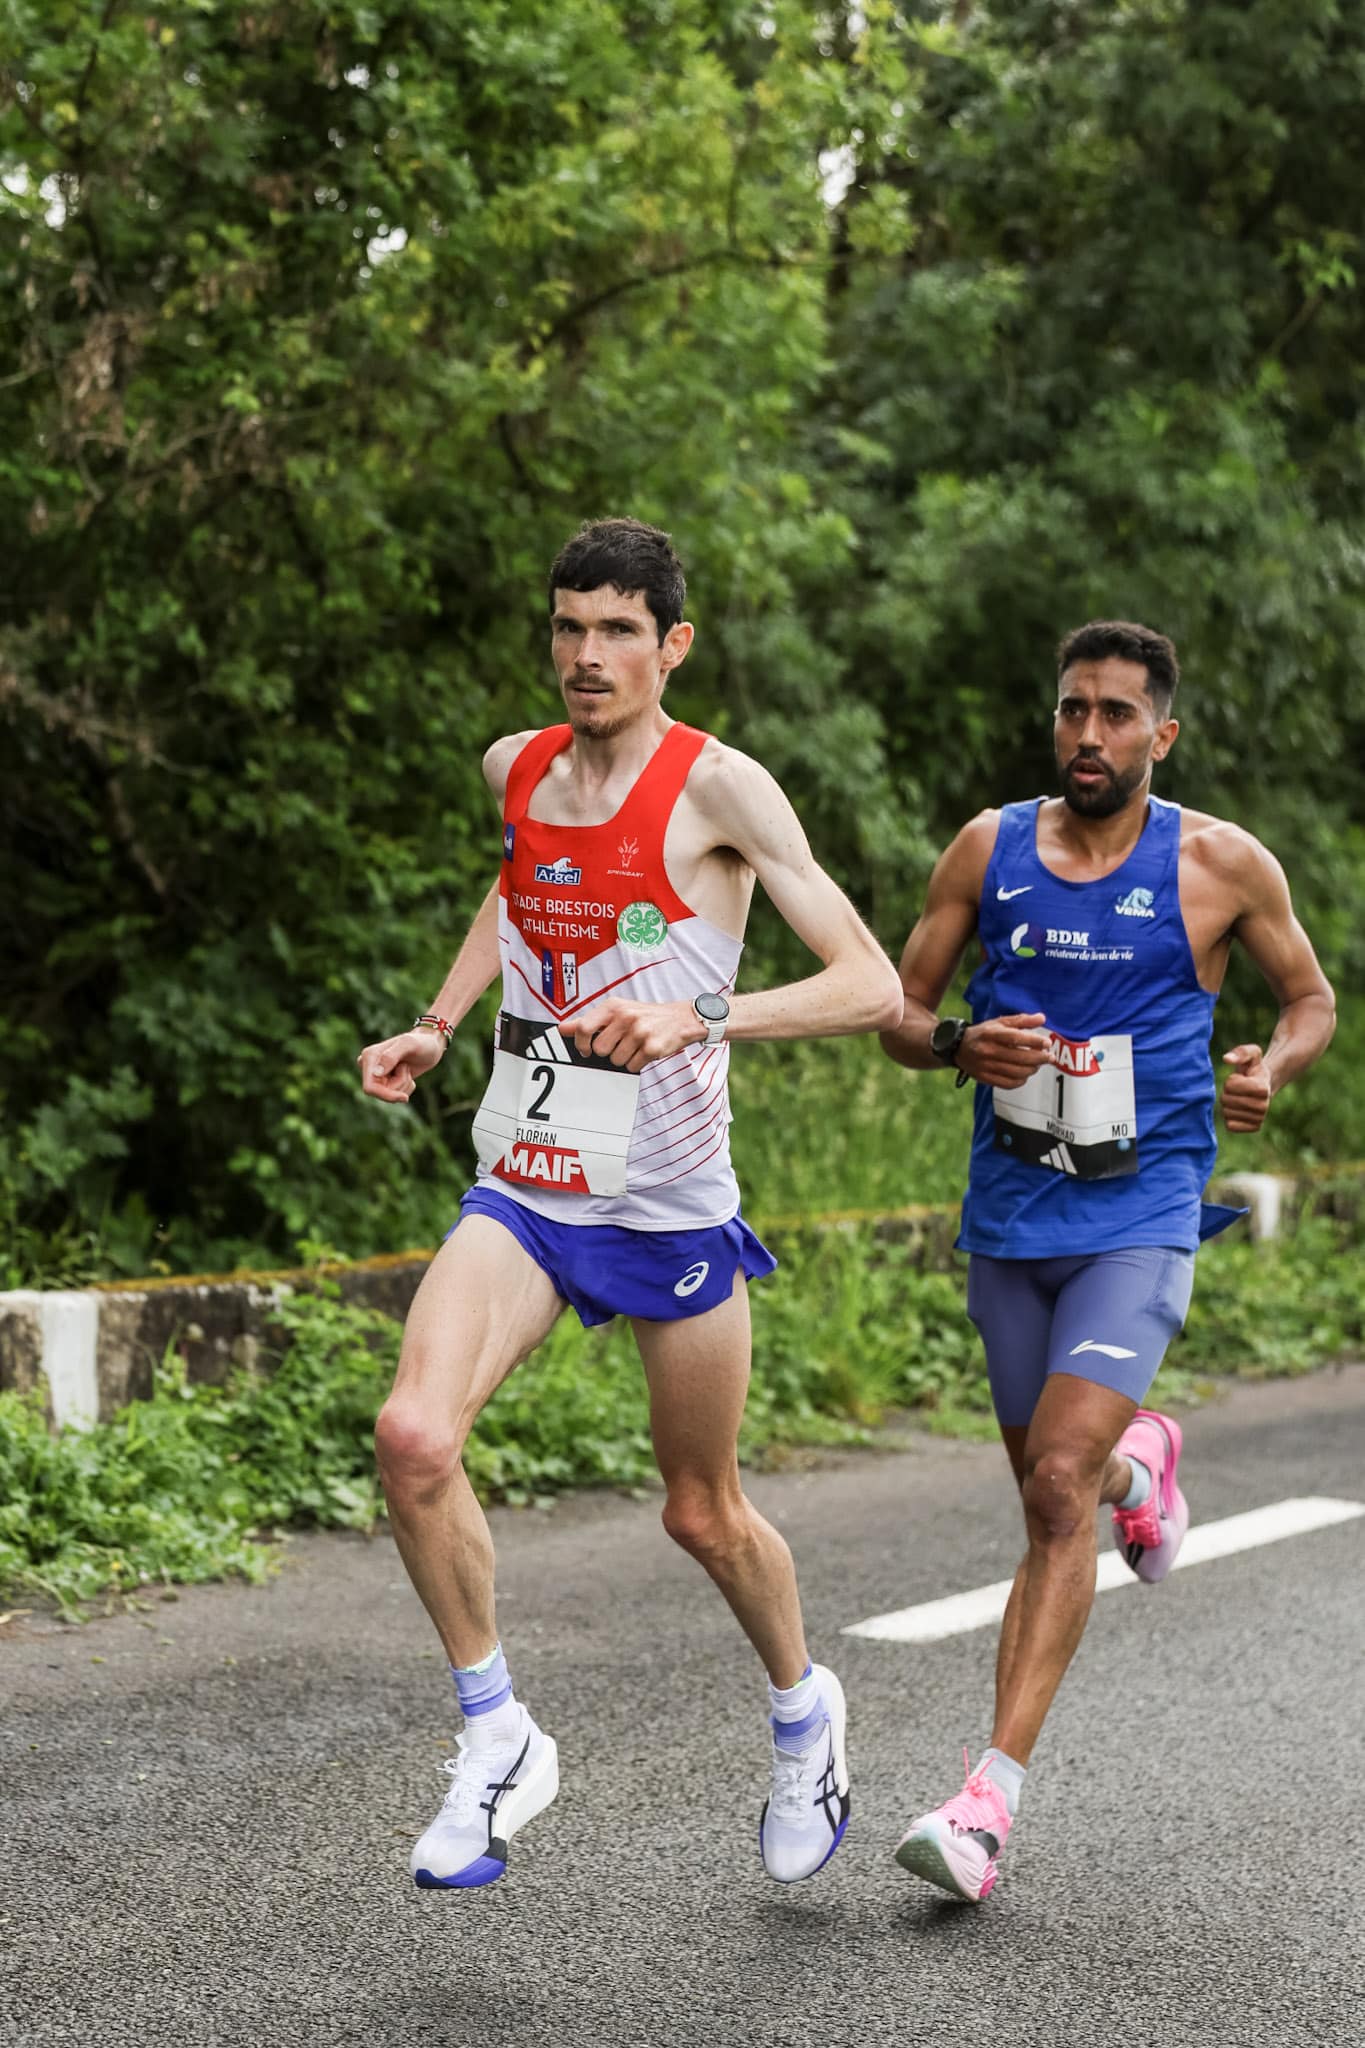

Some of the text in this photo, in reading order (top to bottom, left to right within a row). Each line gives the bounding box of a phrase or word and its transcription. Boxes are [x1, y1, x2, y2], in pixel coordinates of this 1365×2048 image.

[538, 869, 578, 885] Argel
[546, 899, 615, 919] BRESTOIS
[1115, 905, 1155, 918] VEMA
[523, 918, 600, 940] ATHLÉTISME
[1046, 929, 1089, 946] BDM
[1109, 949, 1120, 960] de
[1121, 950, 1134, 960] vie
[526, 1065, 555, 1121] 2
[1056, 1074, 1064, 1119] 1
[516, 1127, 557, 1146] FLORIAN
[1112, 1124, 1128, 1137] MO
[503, 1149, 583, 1184] MAIF
